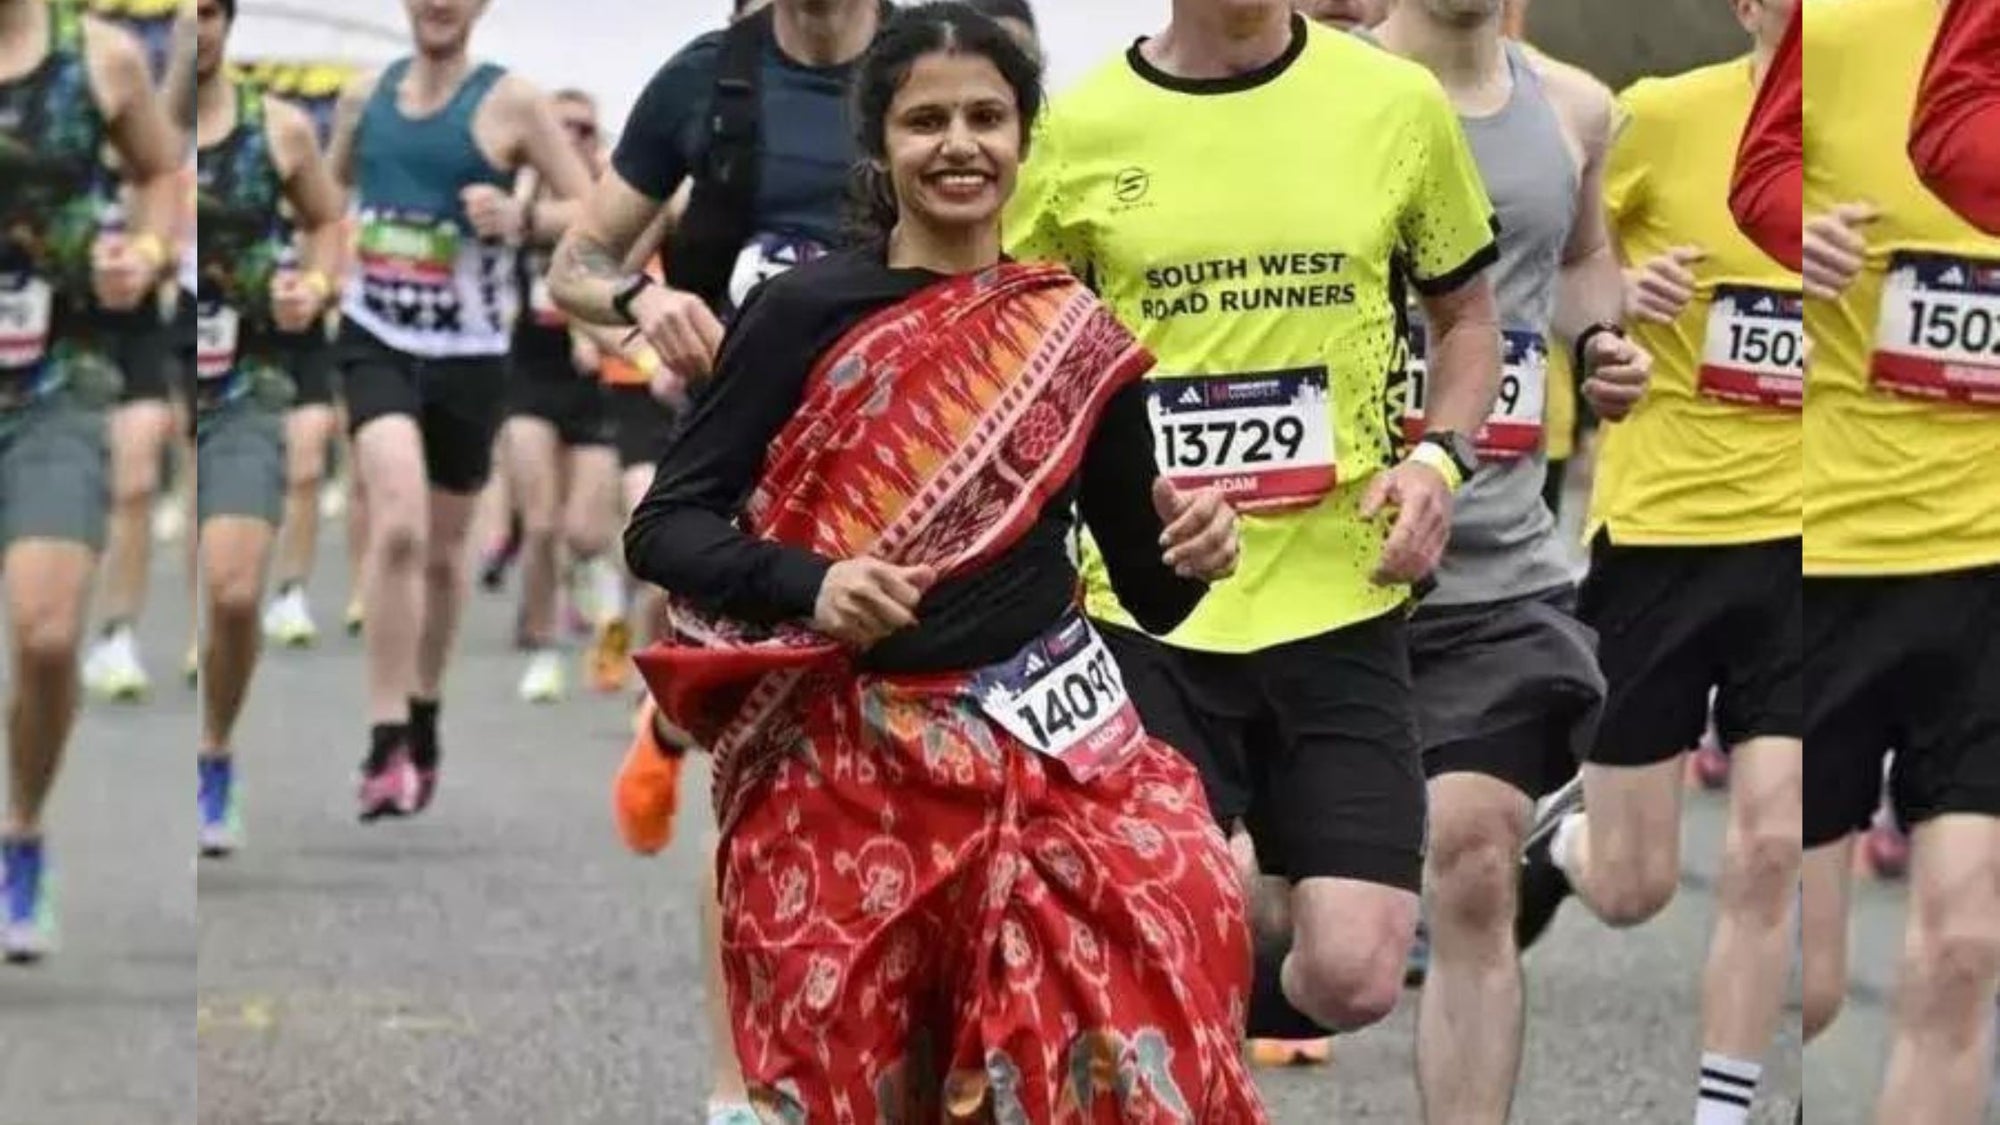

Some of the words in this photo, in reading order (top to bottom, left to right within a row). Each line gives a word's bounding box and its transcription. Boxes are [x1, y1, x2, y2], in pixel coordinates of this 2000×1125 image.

[1145, 258, 1247, 290] SOUTH
[1259, 252, 1345, 276] WEST
[1141, 294, 1208, 321] ROAD
[1220, 284, 1356, 312] RUNNERS
[1728, 323, 1802, 369] 150
[1908, 299, 2000, 354] 150
[1162, 415, 1304, 467] 13729
[1213, 475, 1259, 492] ADAM
